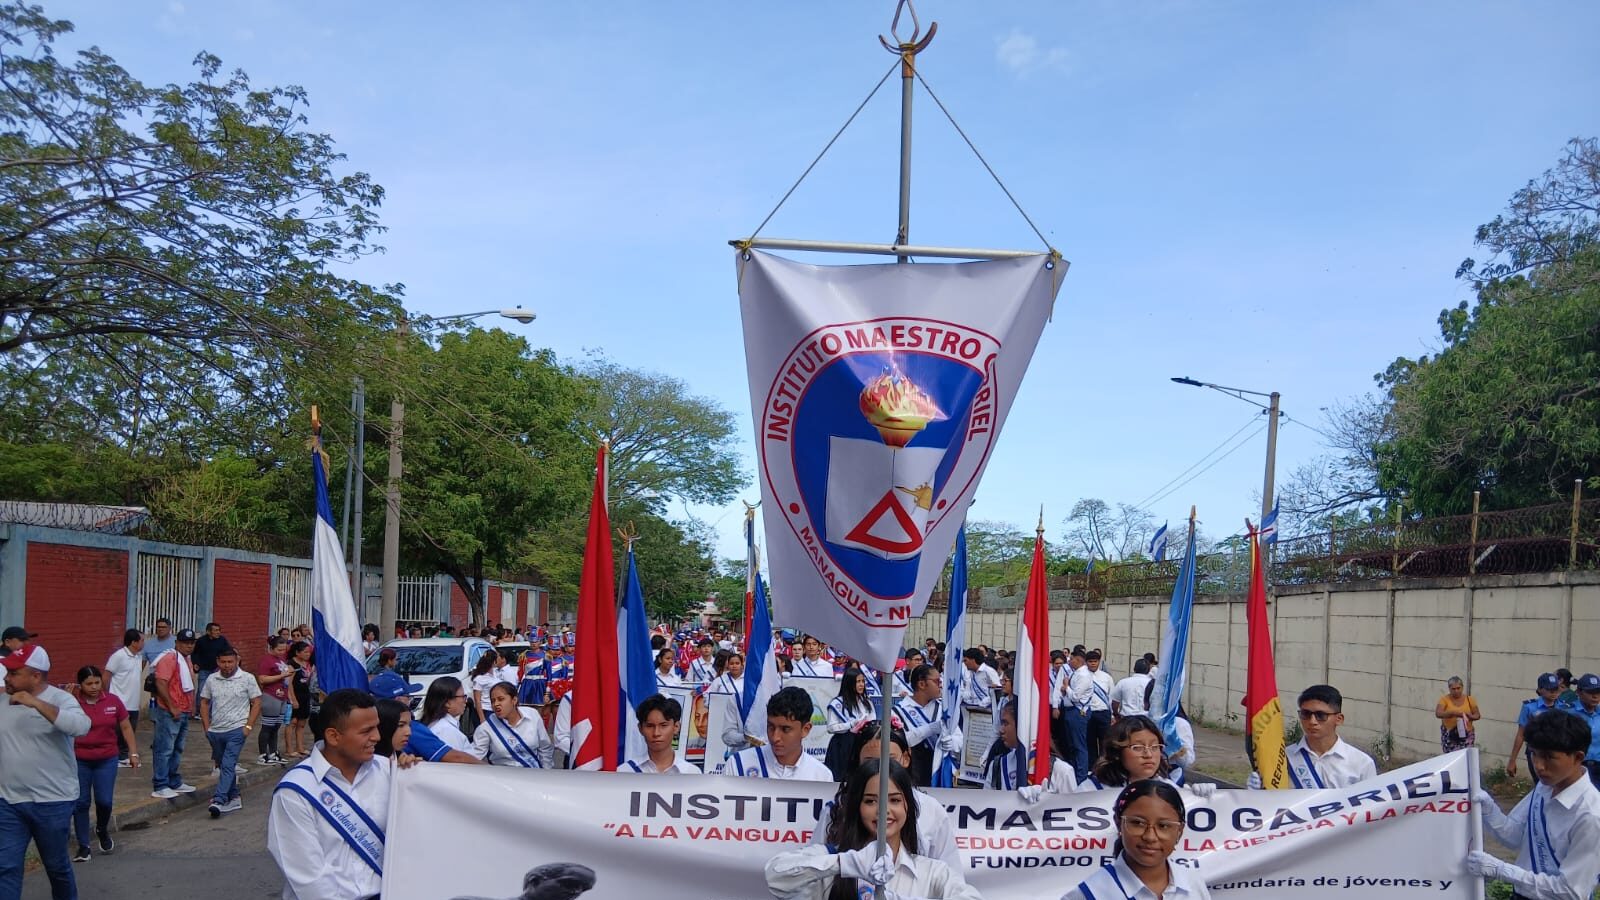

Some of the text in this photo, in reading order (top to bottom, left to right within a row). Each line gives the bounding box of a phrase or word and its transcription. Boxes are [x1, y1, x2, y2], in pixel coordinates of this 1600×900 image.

[767, 333, 843, 442] INSTITUTO
[844, 325, 982, 360] MAESTRO
[800, 526, 870, 618] MANAGUA
[629, 791, 823, 823] INSTIT
[1232, 770, 1470, 832] GABRIEL
[642, 825, 679, 839] LA
[1184, 838, 1217, 851] LA
[1223, 819, 1339, 852] CIENCIA
[1340, 813, 1358, 826] Y
[1365, 809, 1398, 824] LA
[970, 855, 1093, 869] FUNDADO
[1312, 875, 1338, 888] de
[1343, 875, 1432, 889] jóvenes
[1439, 879, 1453, 891] y
